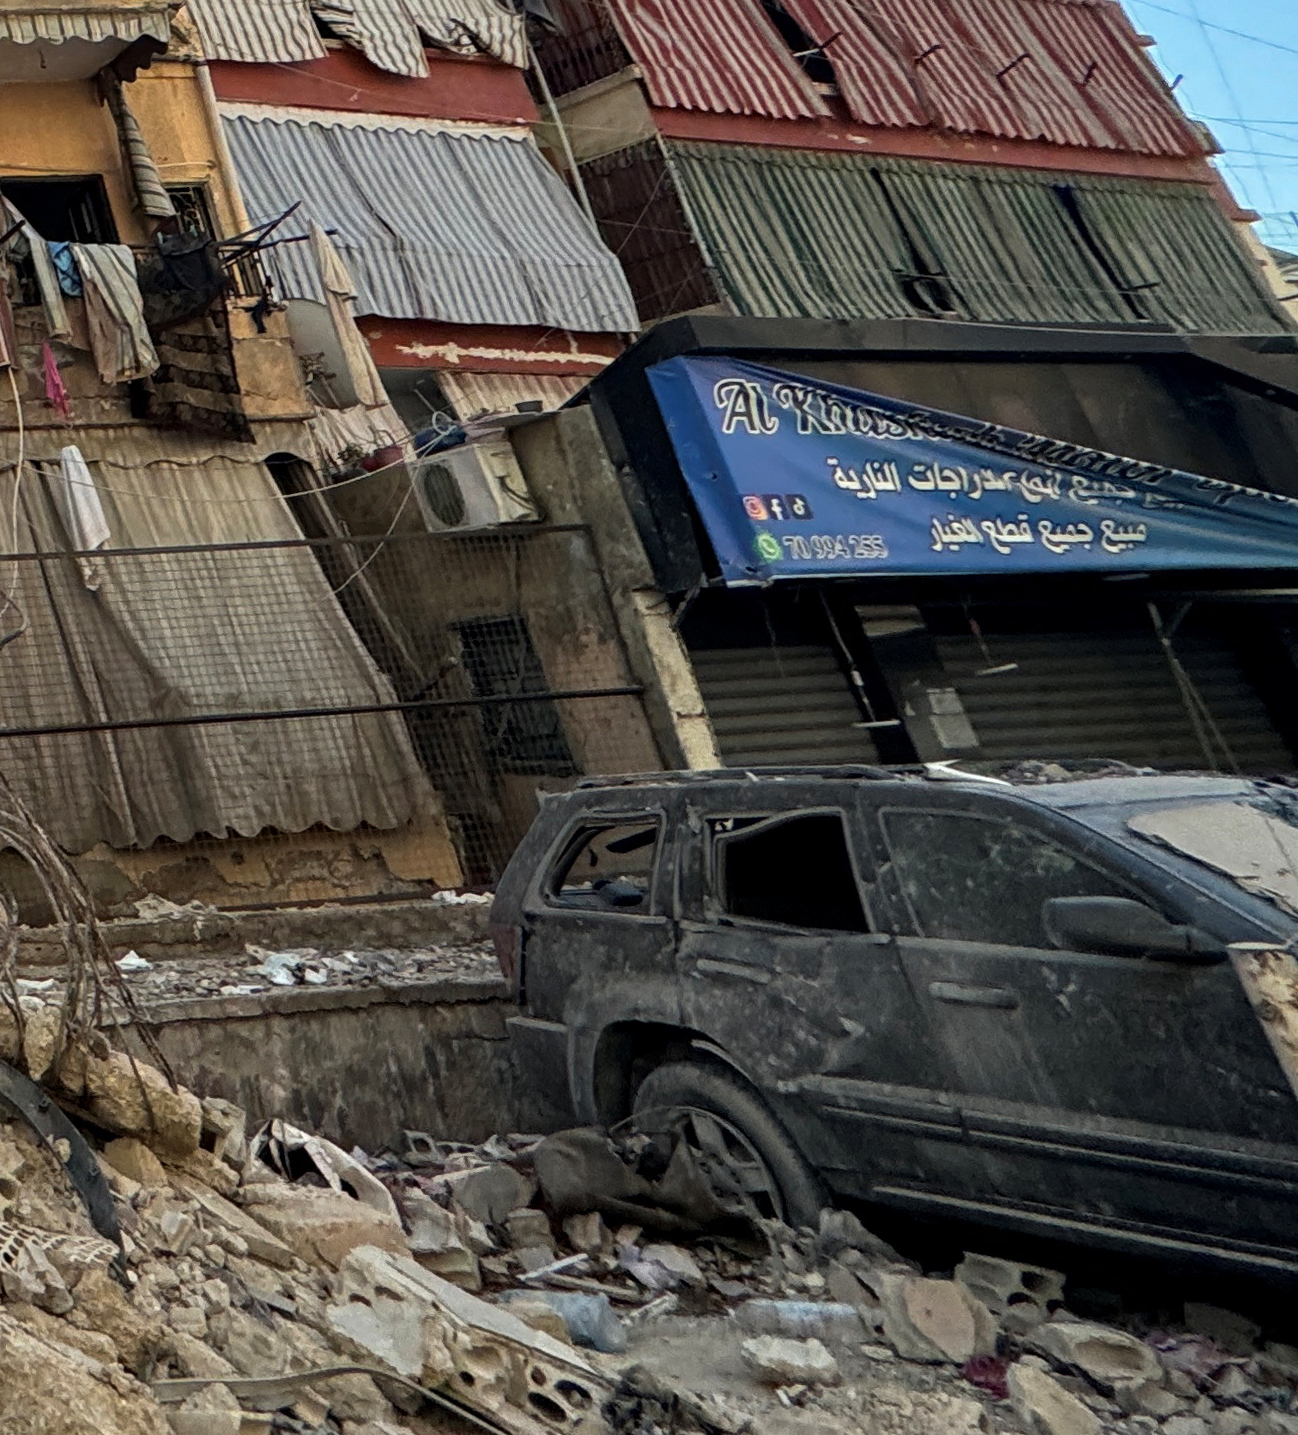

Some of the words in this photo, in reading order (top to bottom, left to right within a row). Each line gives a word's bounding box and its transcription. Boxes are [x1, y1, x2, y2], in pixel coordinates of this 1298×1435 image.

[714, 378, 779, 435] Al
[826, 456, 902, 500] النارية
[930, 514, 984, 552] الغيار
[980, 513, 1035, 554] قطع
[1038, 520, 1094, 553] جميع
[1099, 520, 1147, 553] مبيع
